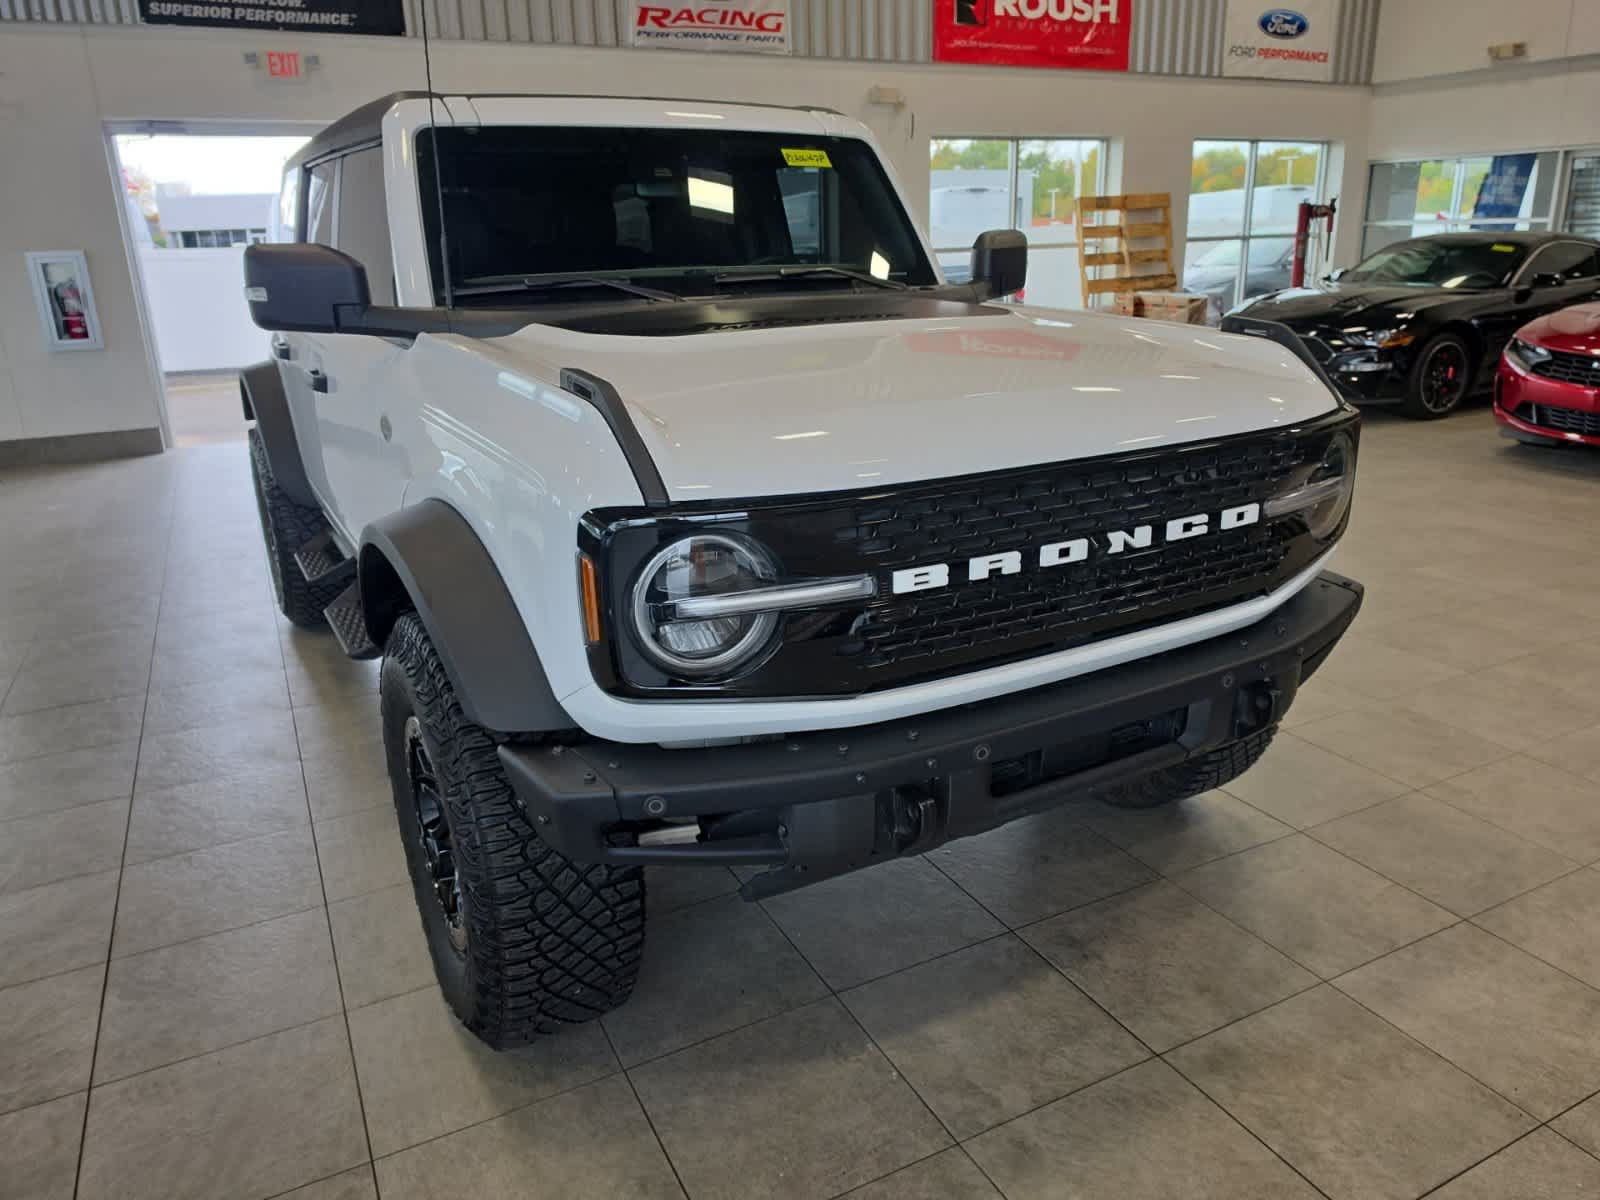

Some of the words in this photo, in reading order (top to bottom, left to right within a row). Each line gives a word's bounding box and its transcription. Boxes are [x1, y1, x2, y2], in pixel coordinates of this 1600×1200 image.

[149, 3, 234, 19] SUPERIOR
[637, 6, 785, 33] RACING
[994, 0, 1119, 24] ROUSH
[1267, 13, 1300, 35] Ford
[636, 30, 740, 41] PERFORMANCE
[745, 35, 785, 43] PARTS
[267, 51, 300, 77] EXIT
[1229, 45, 1256, 58] FORD
[1257, 47, 1329, 63] PERFORMANCE
[892, 502, 1260, 594] BRONCO
